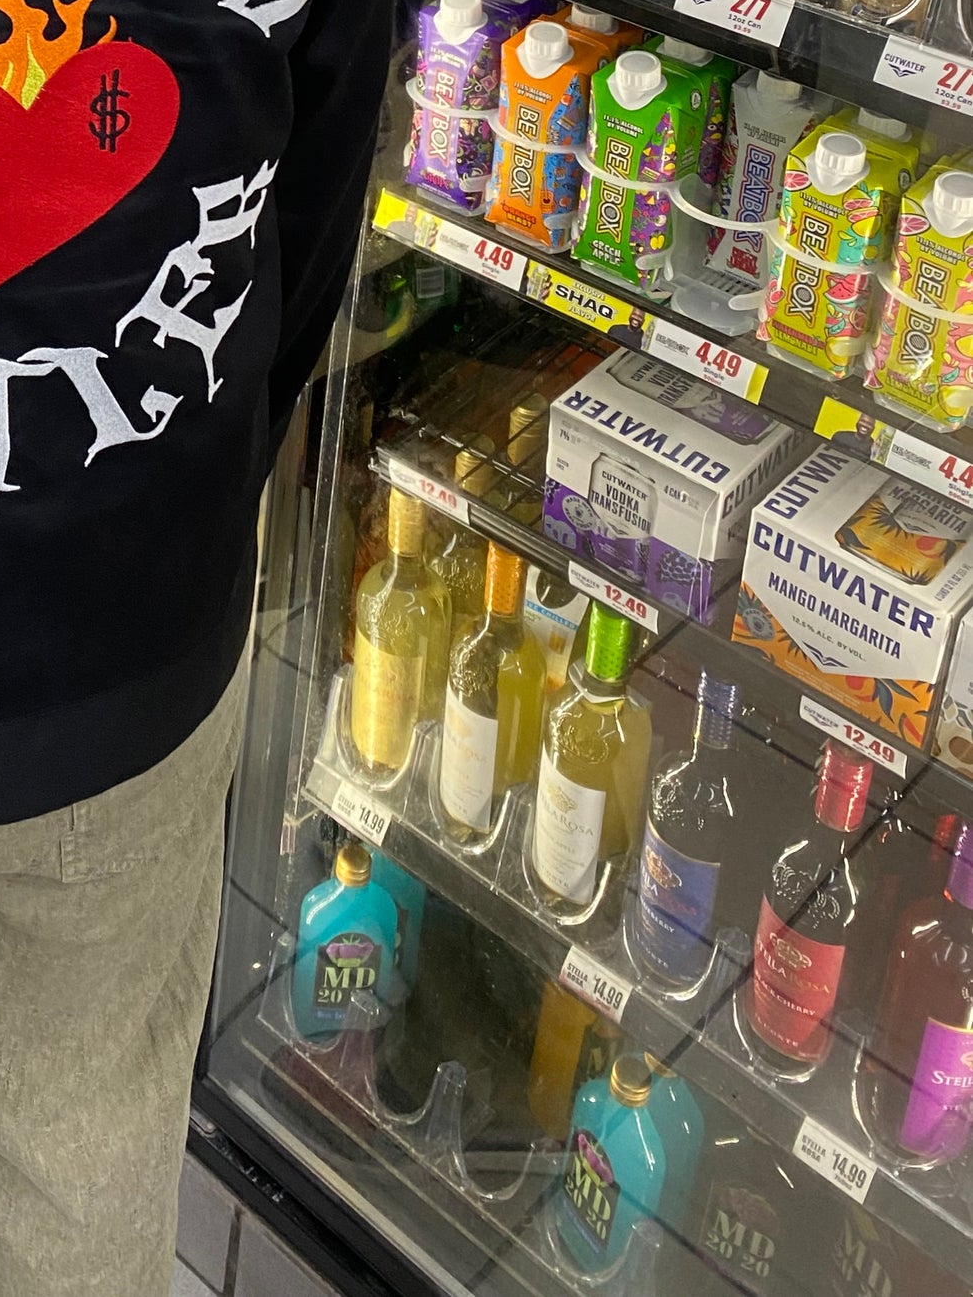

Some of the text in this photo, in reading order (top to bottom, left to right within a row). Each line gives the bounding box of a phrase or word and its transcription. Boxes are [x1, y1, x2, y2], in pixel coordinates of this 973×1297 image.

[728, 13, 762, 30] 12oz Can
[884, 53, 926, 73] CUTWATER
[935, 88, 973, 106] 12oz Can
[617, 124, 638, 138] VOLUME
[621, 119, 644, 133] ALCOHOL
[735, 147, 773, 249] BEATBOX
[474, 239, 513, 271] 4.49
[555, 284, 617, 320] SHAQ
[695, 341, 742, 378] 4.49
[563, 389, 731, 485] CUTWATER
[602, 470, 649, 501] CUTWATER
[606, 483, 640, 514] VODKA
[764, 446, 850, 520] CUTWA
[590, 489, 653, 535] TRANSFUSION
[753, 521, 935, 639] CUTWATER
[604, 584, 648, 620] 12.49
[768, 571, 901, 660] MANGO MARGARITA
[837, 640, 849, 651] BY
[843, 724, 895, 764] 12.49
[322, 966, 376, 989] MD
[566, 962, 588, 982] STELLA
[317, 988, 343, 1003] 20
[802, 1134, 826, 1158] STELLA
[574, 1155, 612, 1222] MD
[565, 1176, 607, 1240] 20 20
[715, 1208, 777, 1259] MD
[740, 1255, 771, 1278] 20
